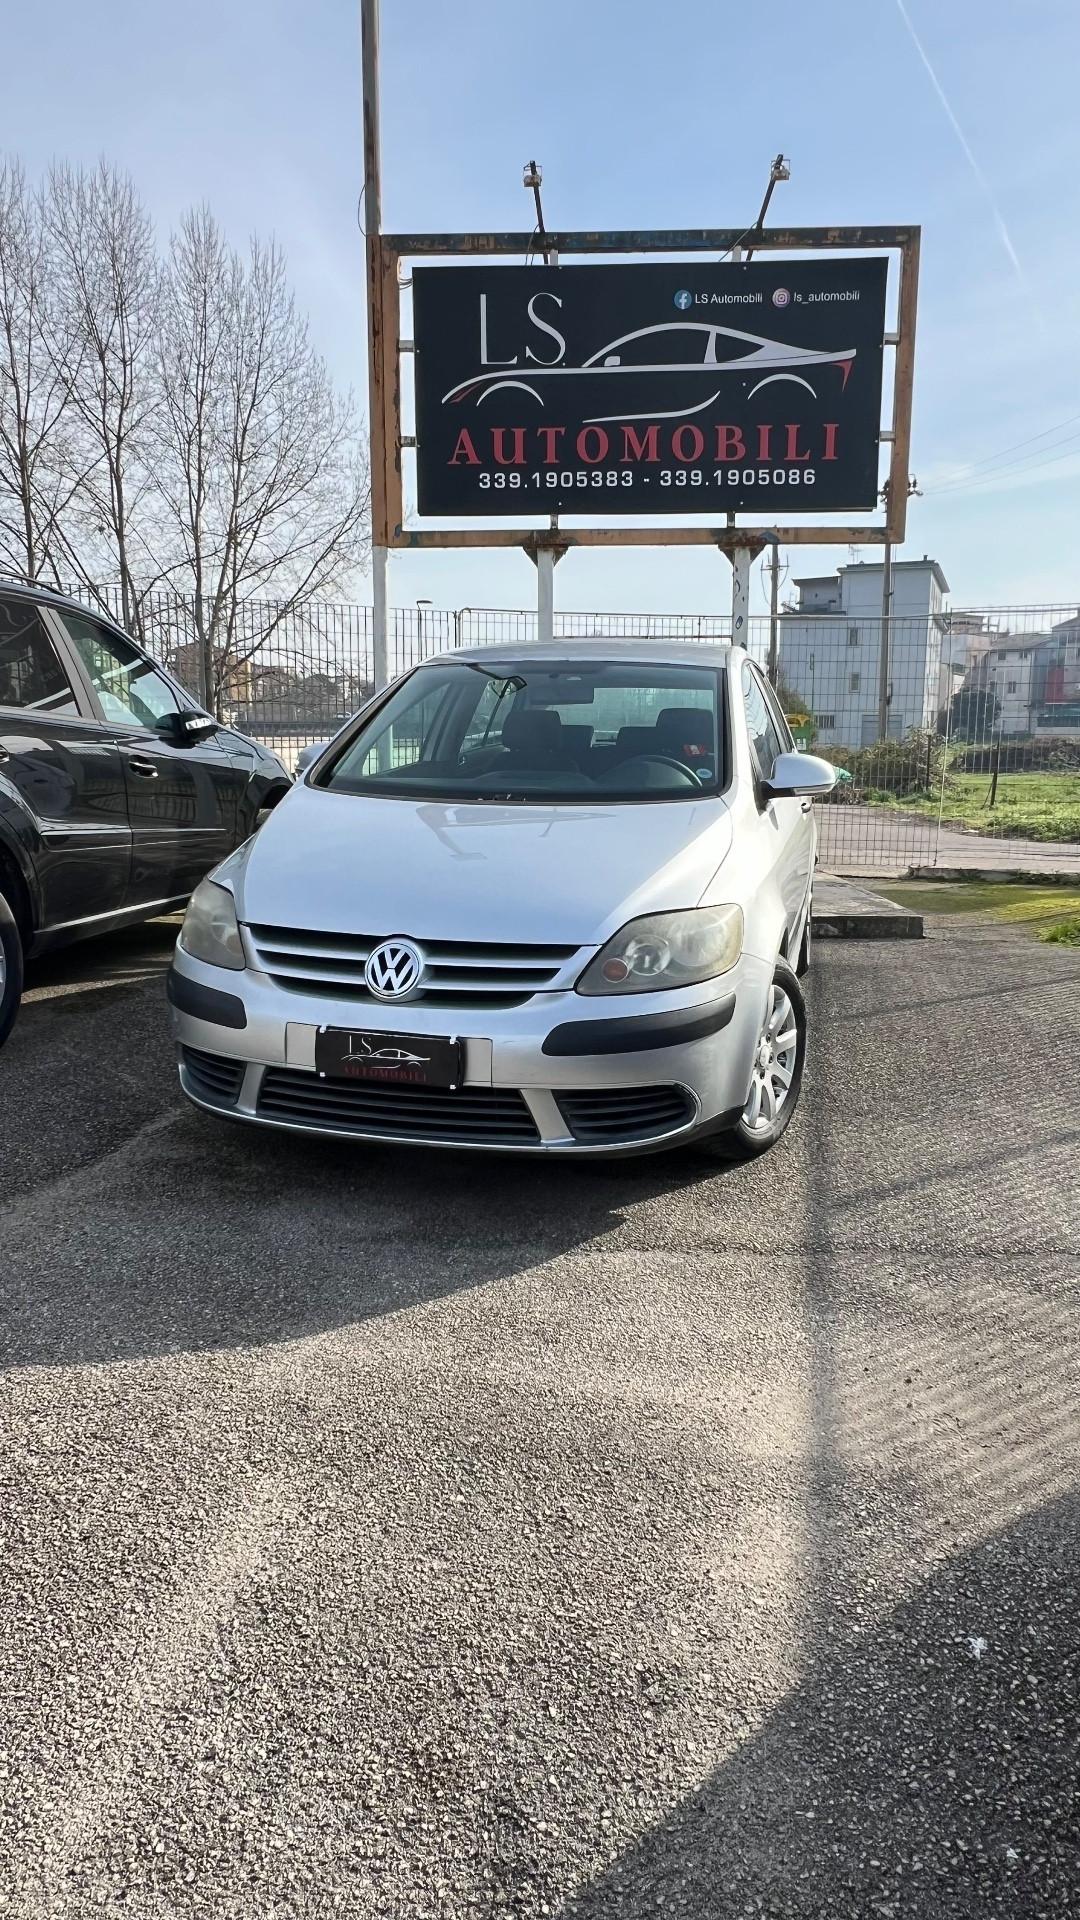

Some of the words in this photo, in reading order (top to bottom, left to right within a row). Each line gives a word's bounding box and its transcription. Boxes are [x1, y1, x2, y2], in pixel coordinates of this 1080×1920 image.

[695, 293, 709, 304] LS
[710, 292, 763, 304] Automobili
[793, 290, 860, 305] ls_automobili
[480, 292, 566, 366] LS
[447, 423, 840, 465] AUTOMOBILI
[478, 471, 634, 489] 339.1905383
[659, 469, 816, 487] 339.1905086
[368, 943, 420, 997] VW
